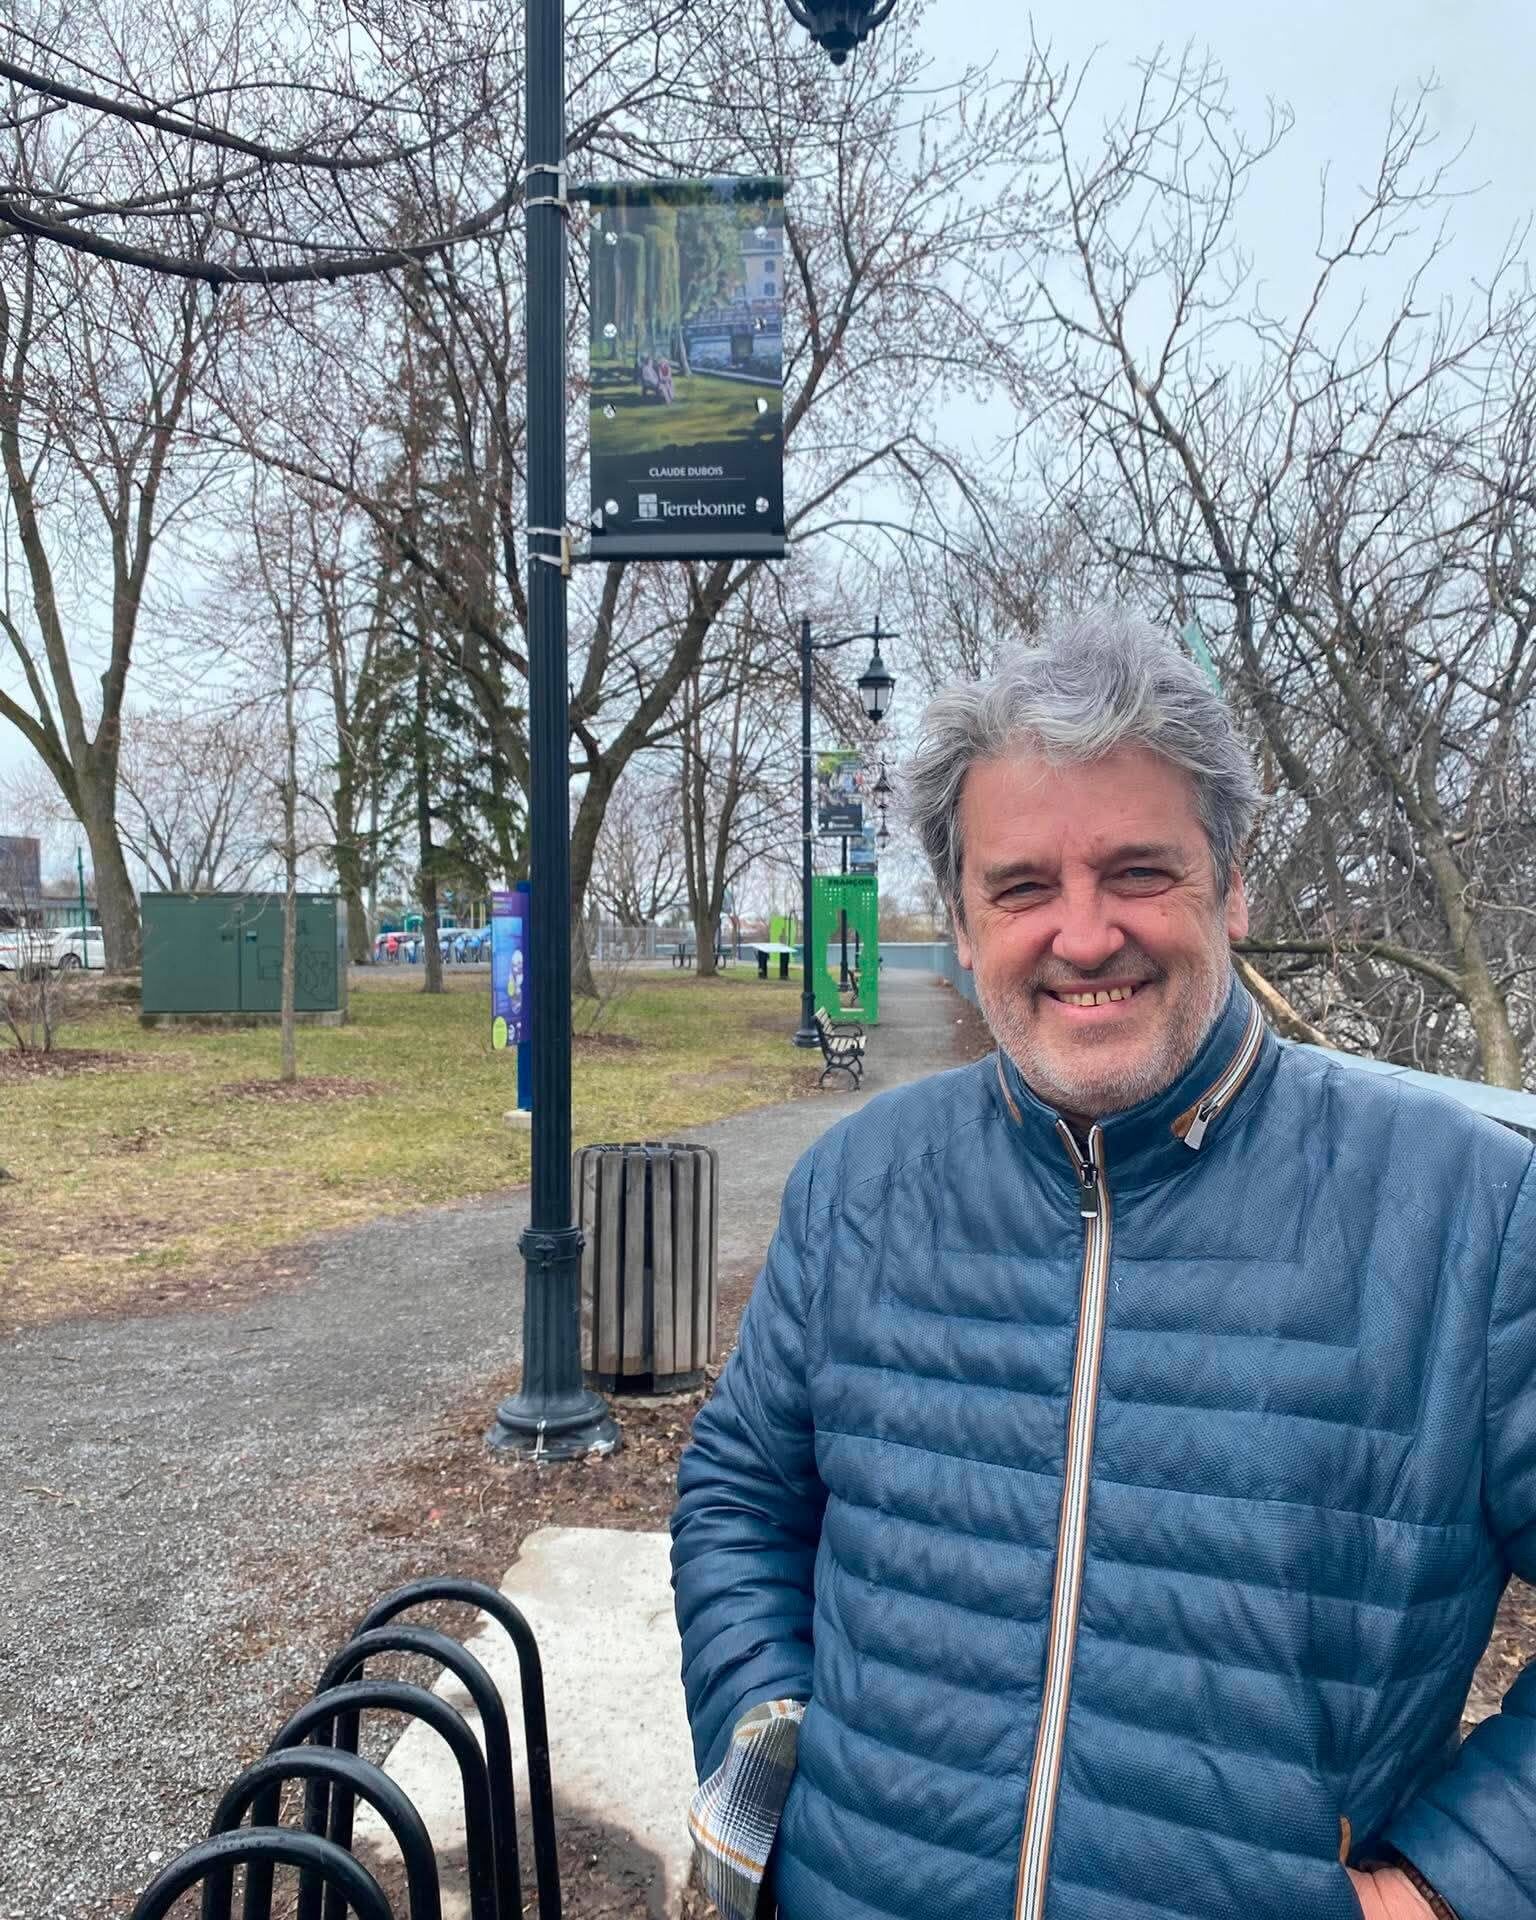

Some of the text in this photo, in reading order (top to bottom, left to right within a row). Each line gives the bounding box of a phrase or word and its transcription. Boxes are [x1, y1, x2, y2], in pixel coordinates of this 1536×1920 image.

[649, 466, 723, 477] CLAUDE DUBOIS
[660, 500, 746, 517] Terrebonne
